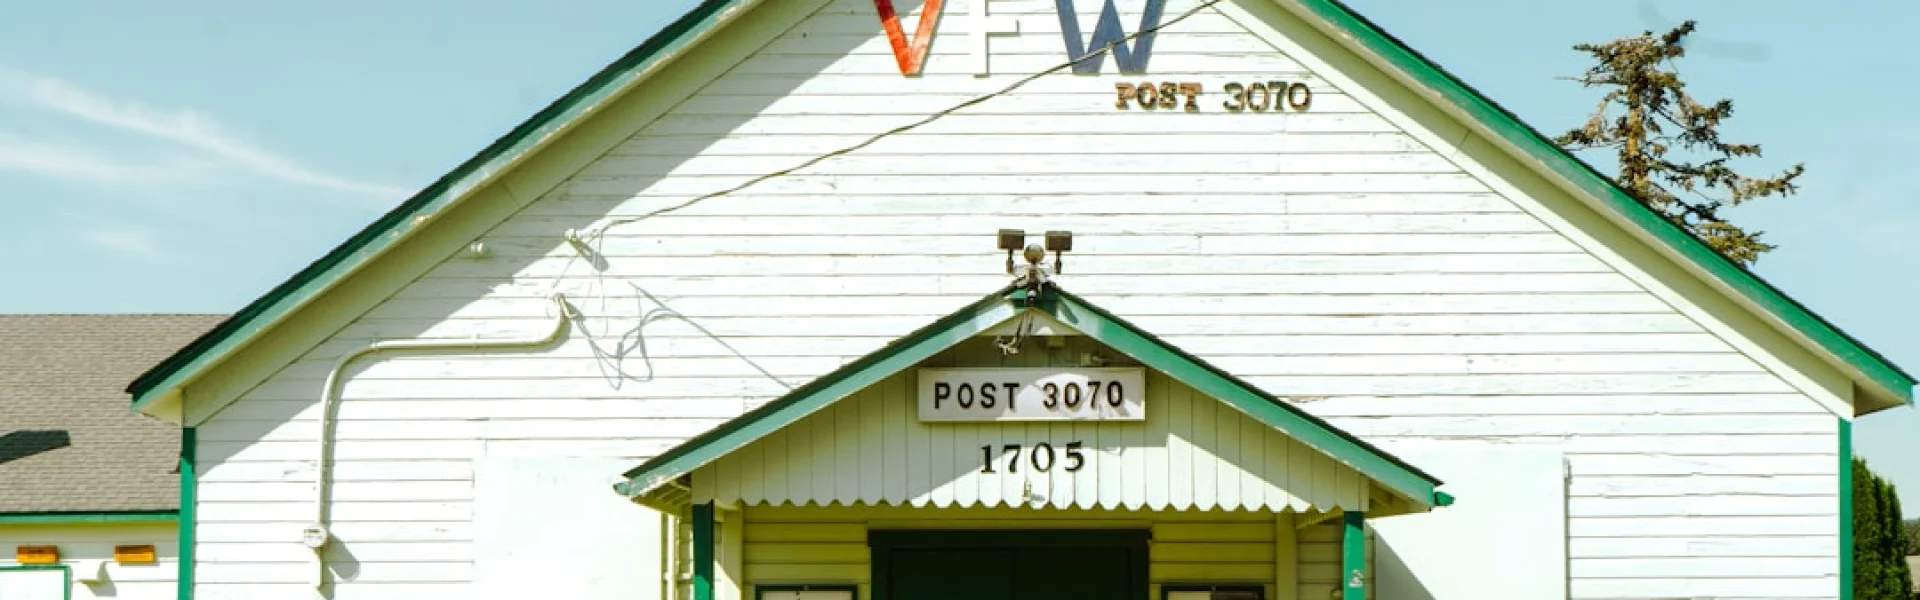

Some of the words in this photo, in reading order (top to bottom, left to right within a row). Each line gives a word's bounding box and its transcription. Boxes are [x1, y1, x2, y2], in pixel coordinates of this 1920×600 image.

[873, 0, 1167, 76] VFW
[1114, 82, 1202, 112] POST
[1223, 82, 1312, 113] 3070
[934, 382, 1020, 410] POST
[1042, 381, 1124, 410] 3070
[980, 440, 1085, 474] 1705
